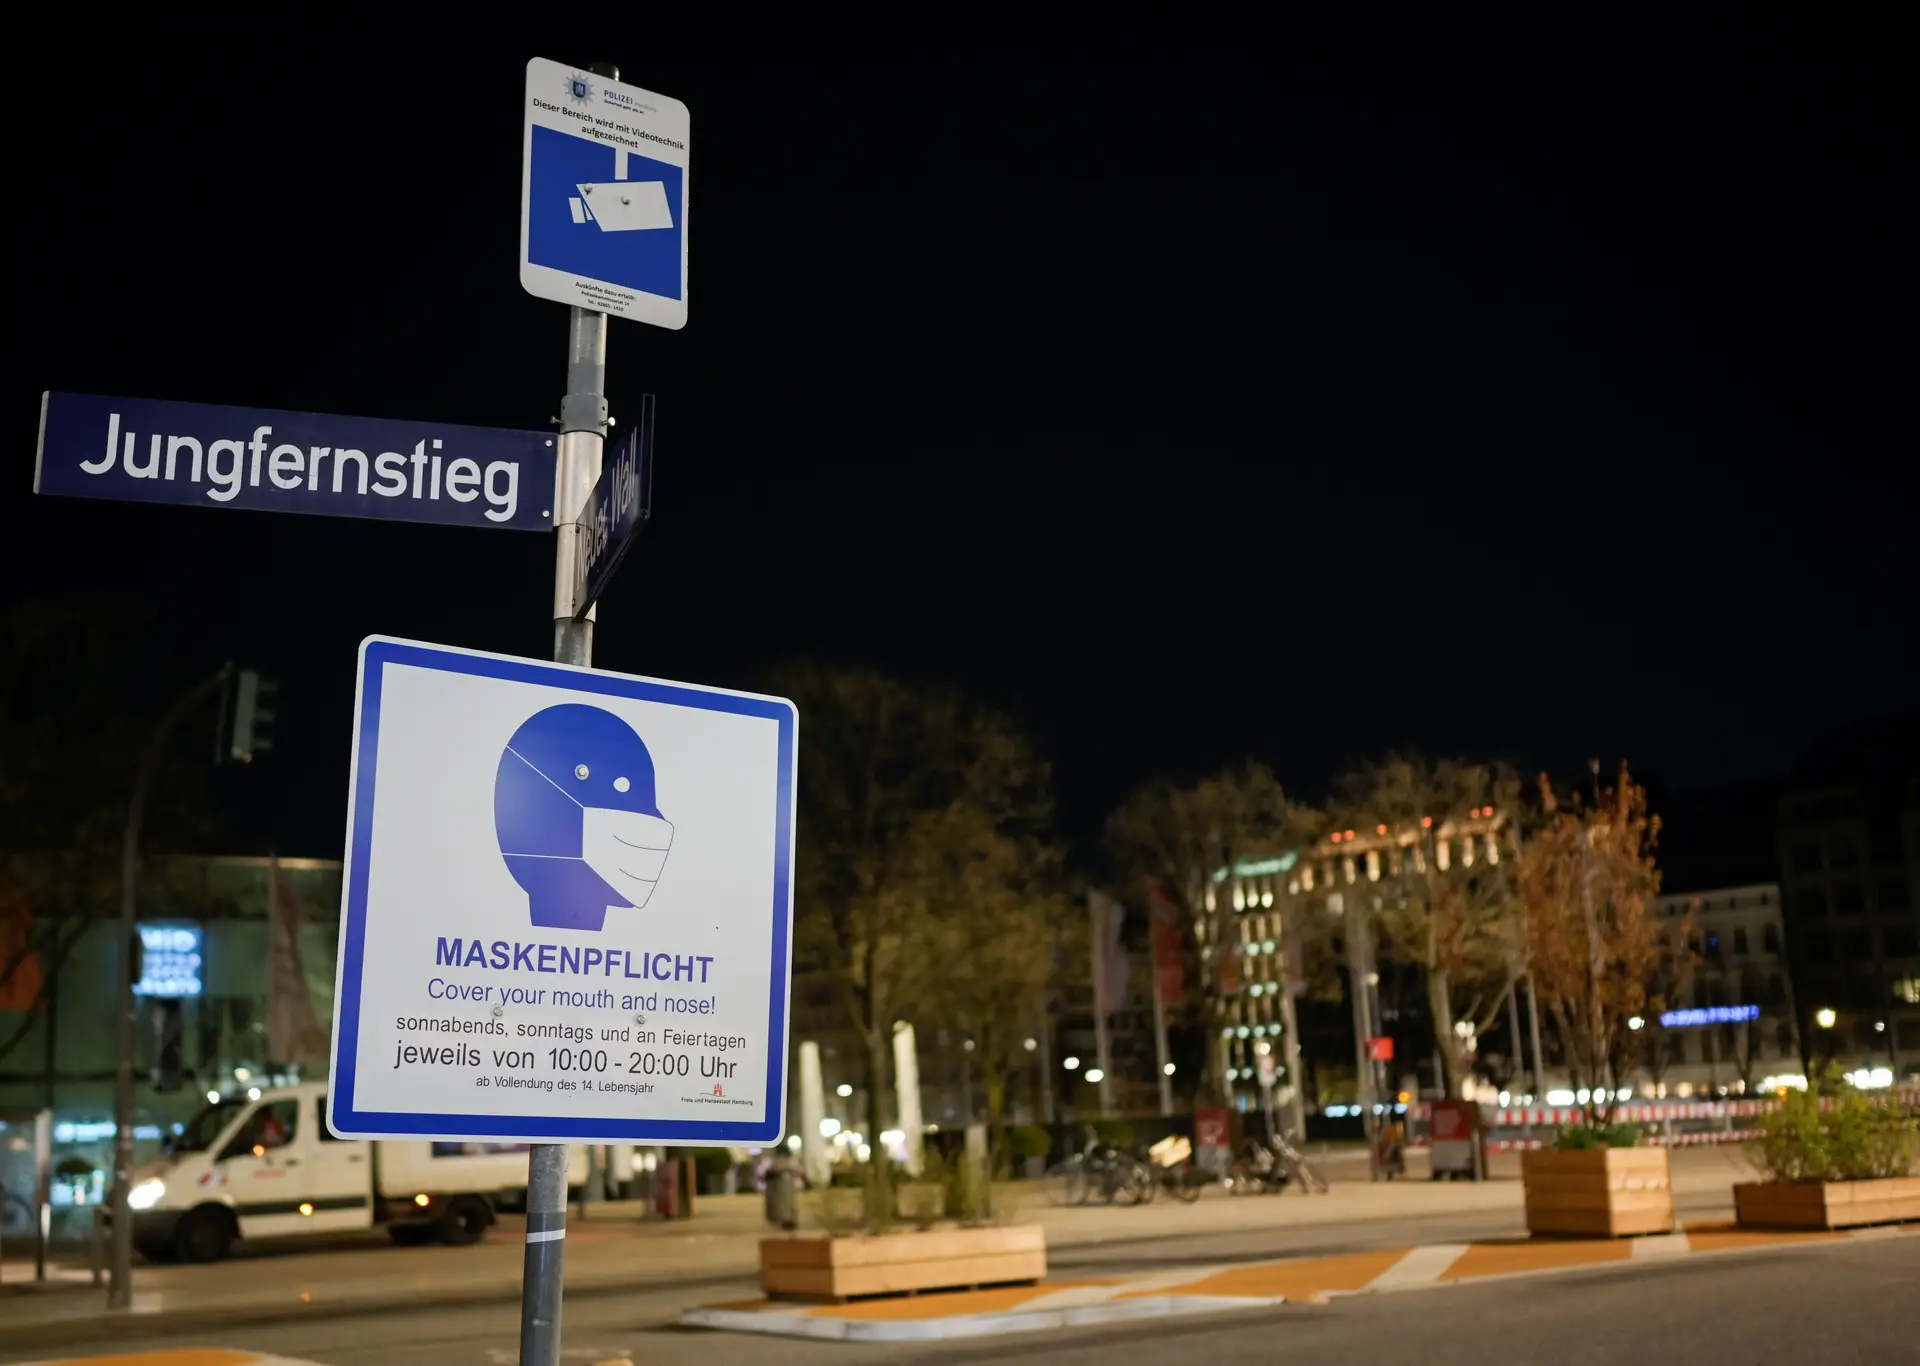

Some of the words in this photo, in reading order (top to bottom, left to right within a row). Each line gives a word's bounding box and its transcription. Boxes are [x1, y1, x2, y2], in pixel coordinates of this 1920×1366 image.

[604, 89, 633, 104] POLIZEI
[533, 98, 559, 113] Dieser
[562, 107, 593, 123] Bereich
[595, 116, 614, 129] wird
[616, 124, 629, 134] mit
[632, 128, 684, 150] Videotechnik
[582, 126, 638, 148] aufgezeichnet
[575, 282, 603, 293] Auskünfte
[618, 293, 636, 301] erteilt:
[79, 413, 520, 522] Jungfernstieg
[575, 497, 608, 590] Neuer
[611, 426, 638, 532] Wall
[436, 937, 713, 983] MASKENPFLICHT
[428, 978, 493, 1001] Cover
[499, 986, 545, 1006] your
[553, 988, 614, 1009] mouth
[621, 992, 657, 1011] and
[664, 996, 715, 1014] nose!
[396, 1016, 509, 1038] sonnabends,
[517, 1021, 593, 1043] sonntags
[601, 1026, 629, 1042] und
[637, 1030, 655, 1043] an
[663, 1029, 746, 1051] Feiertagen
[394, 1040, 481, 1070] jeweils
[493, 1051, 534, 1069] von
[548, 1048, 607, 1072] 10:00
[629, 1053, 689, 1076] 20:00
[700, 1055, 737, 1078] Uhr
[476, 1076, 490, 1087] ab
[495, 1076, 553, 1092] Vollendung
[558, 1079, 576, 1090] des
[582, 1080, 594, 1091] 14.
[599, 1081, 654, 1095] Lebensjahr
